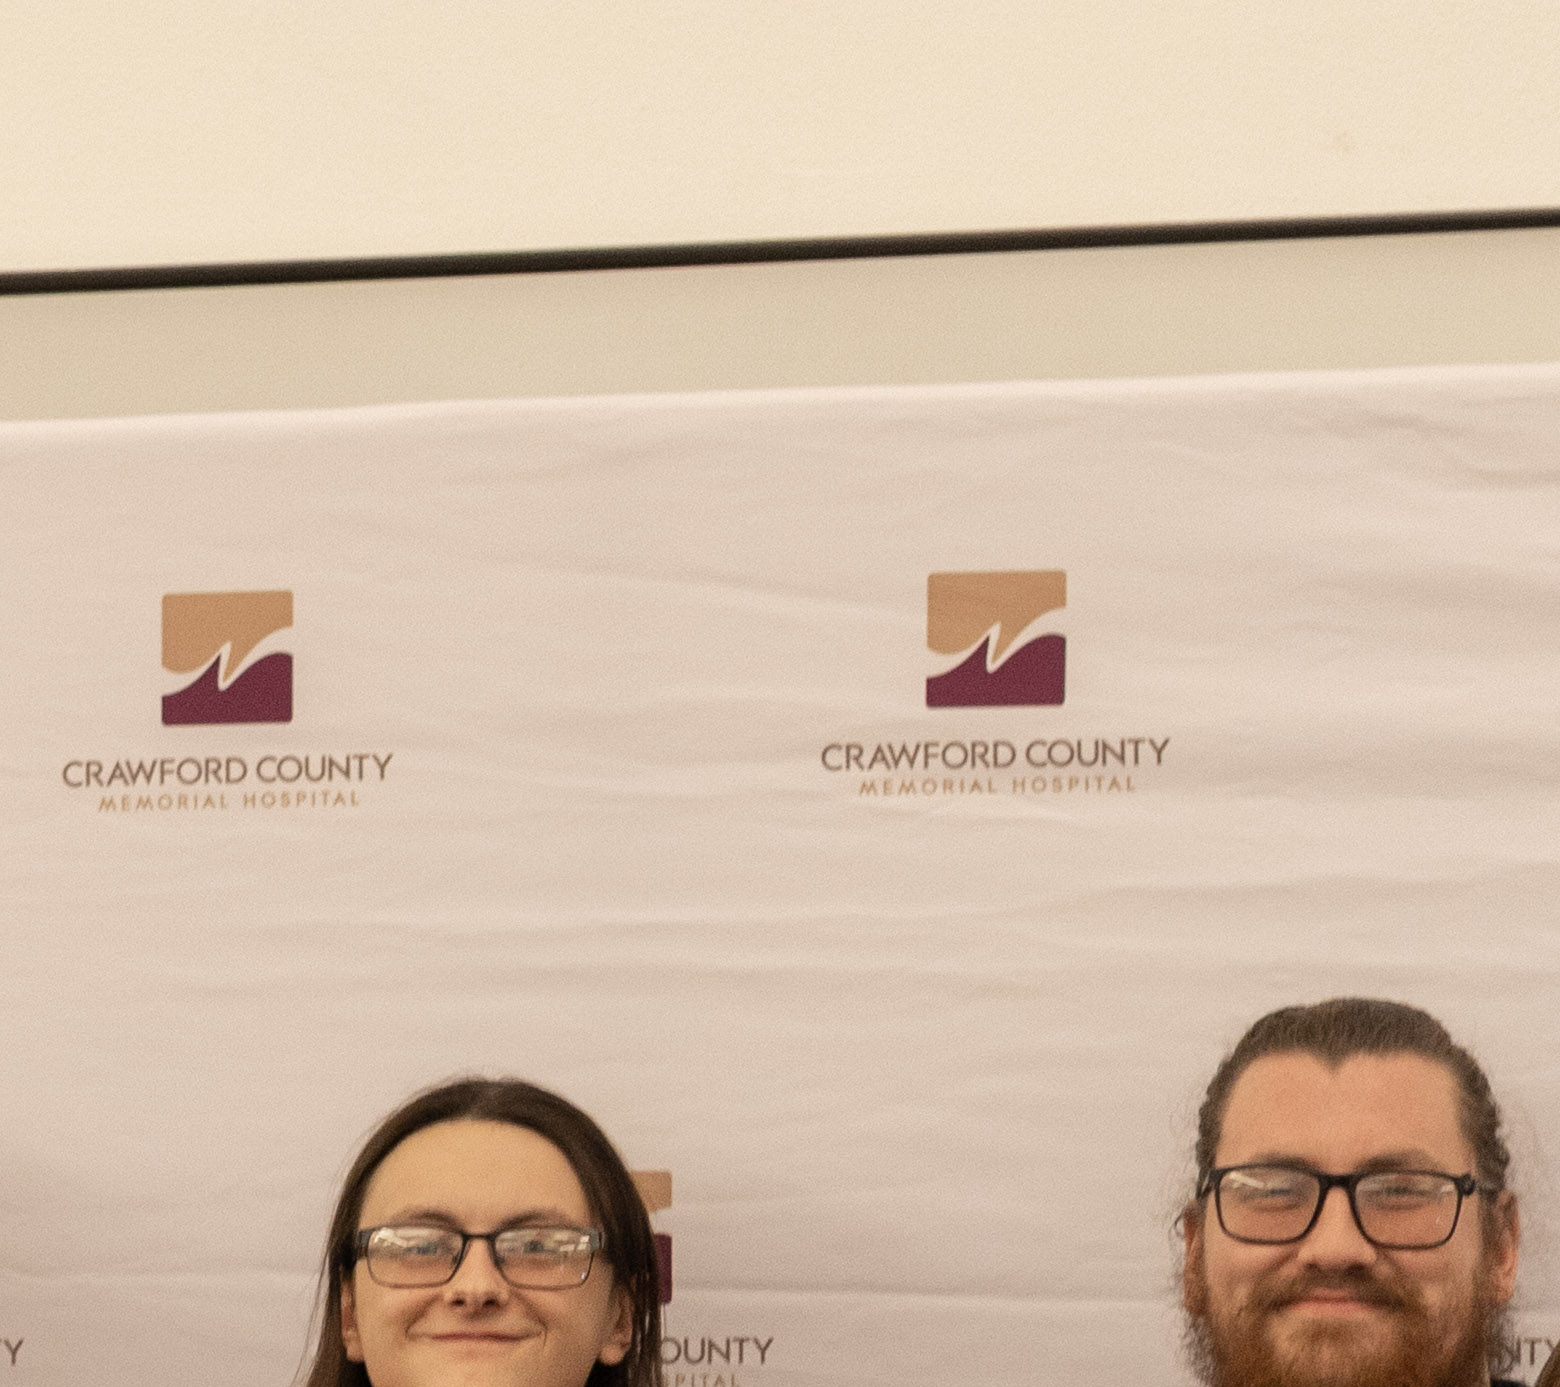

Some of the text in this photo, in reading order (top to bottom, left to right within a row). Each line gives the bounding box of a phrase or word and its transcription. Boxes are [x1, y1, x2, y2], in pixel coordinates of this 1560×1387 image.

[821, 737, 1170, 772] CRAWFORD COUNTY
[62, 753, 393, 788] CRAWFORD COUNTY
[859, 774, 1136, 796] MEMORIAL HOSPITAL
[98, 790, 360, 813] MEMORIAL HOSPITAL
[661, 1336, 774, 1365] OUNTY
